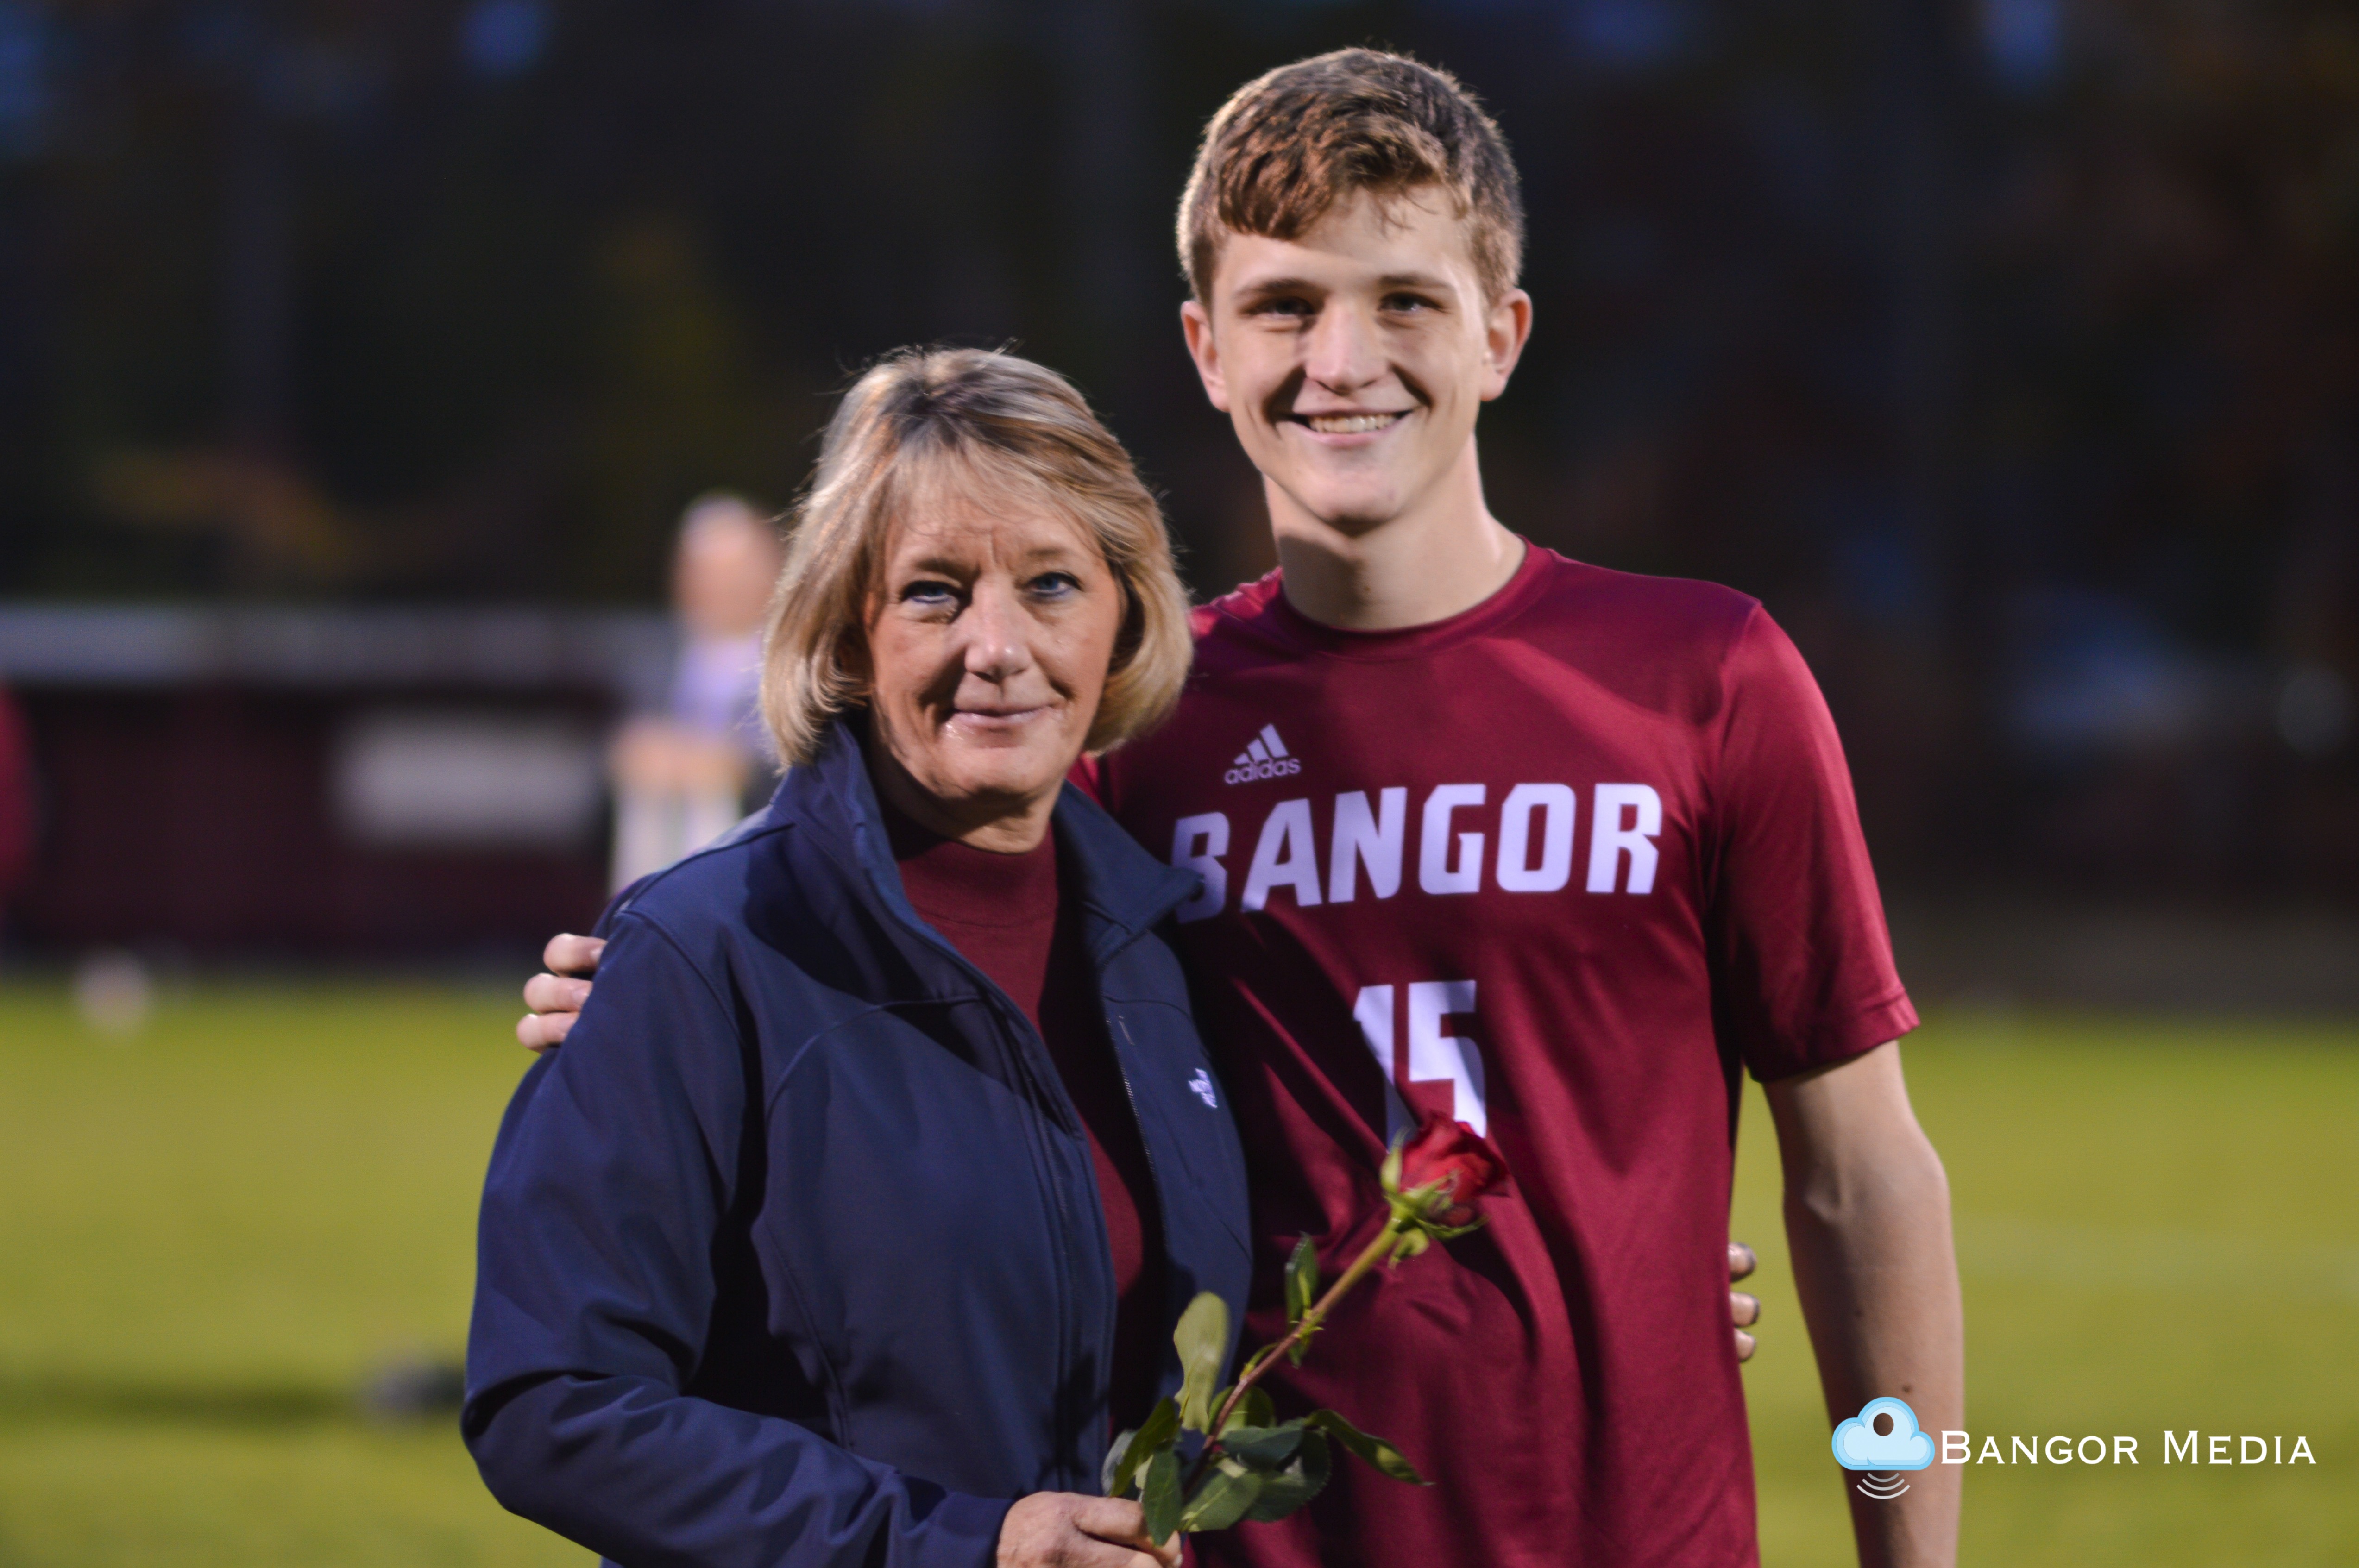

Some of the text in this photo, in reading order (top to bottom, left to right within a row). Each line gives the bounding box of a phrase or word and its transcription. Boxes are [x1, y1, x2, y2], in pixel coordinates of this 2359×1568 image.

[1224, 758, 1301, 784] adidas
[1170, 783, 1662, 923] BANGOR
[1353, 980, 1487, 1152] 15
